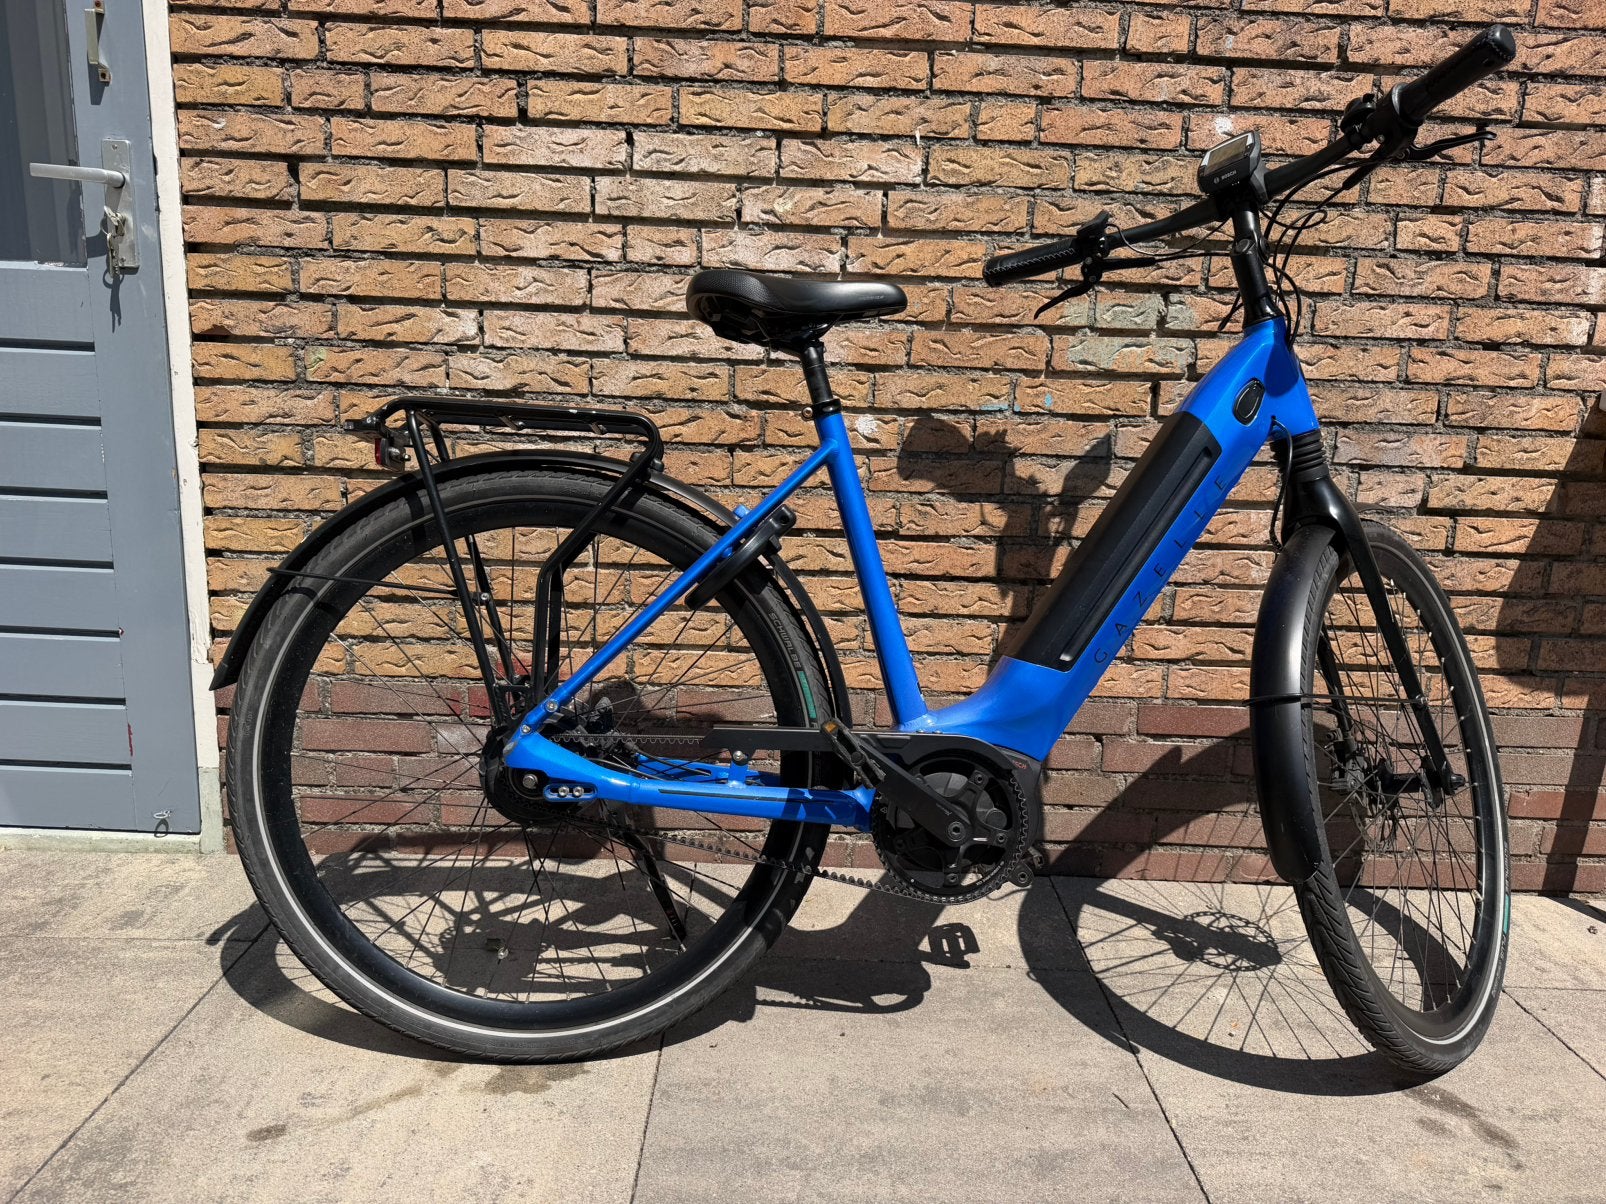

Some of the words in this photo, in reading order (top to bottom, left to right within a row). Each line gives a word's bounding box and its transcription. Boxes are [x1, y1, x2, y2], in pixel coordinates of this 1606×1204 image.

[1221, 170, 1236, 180] BOSCH
[1094, 475, 1226, 664] GAZELLE
[769, 612, 802, 668] SCHWALBE
